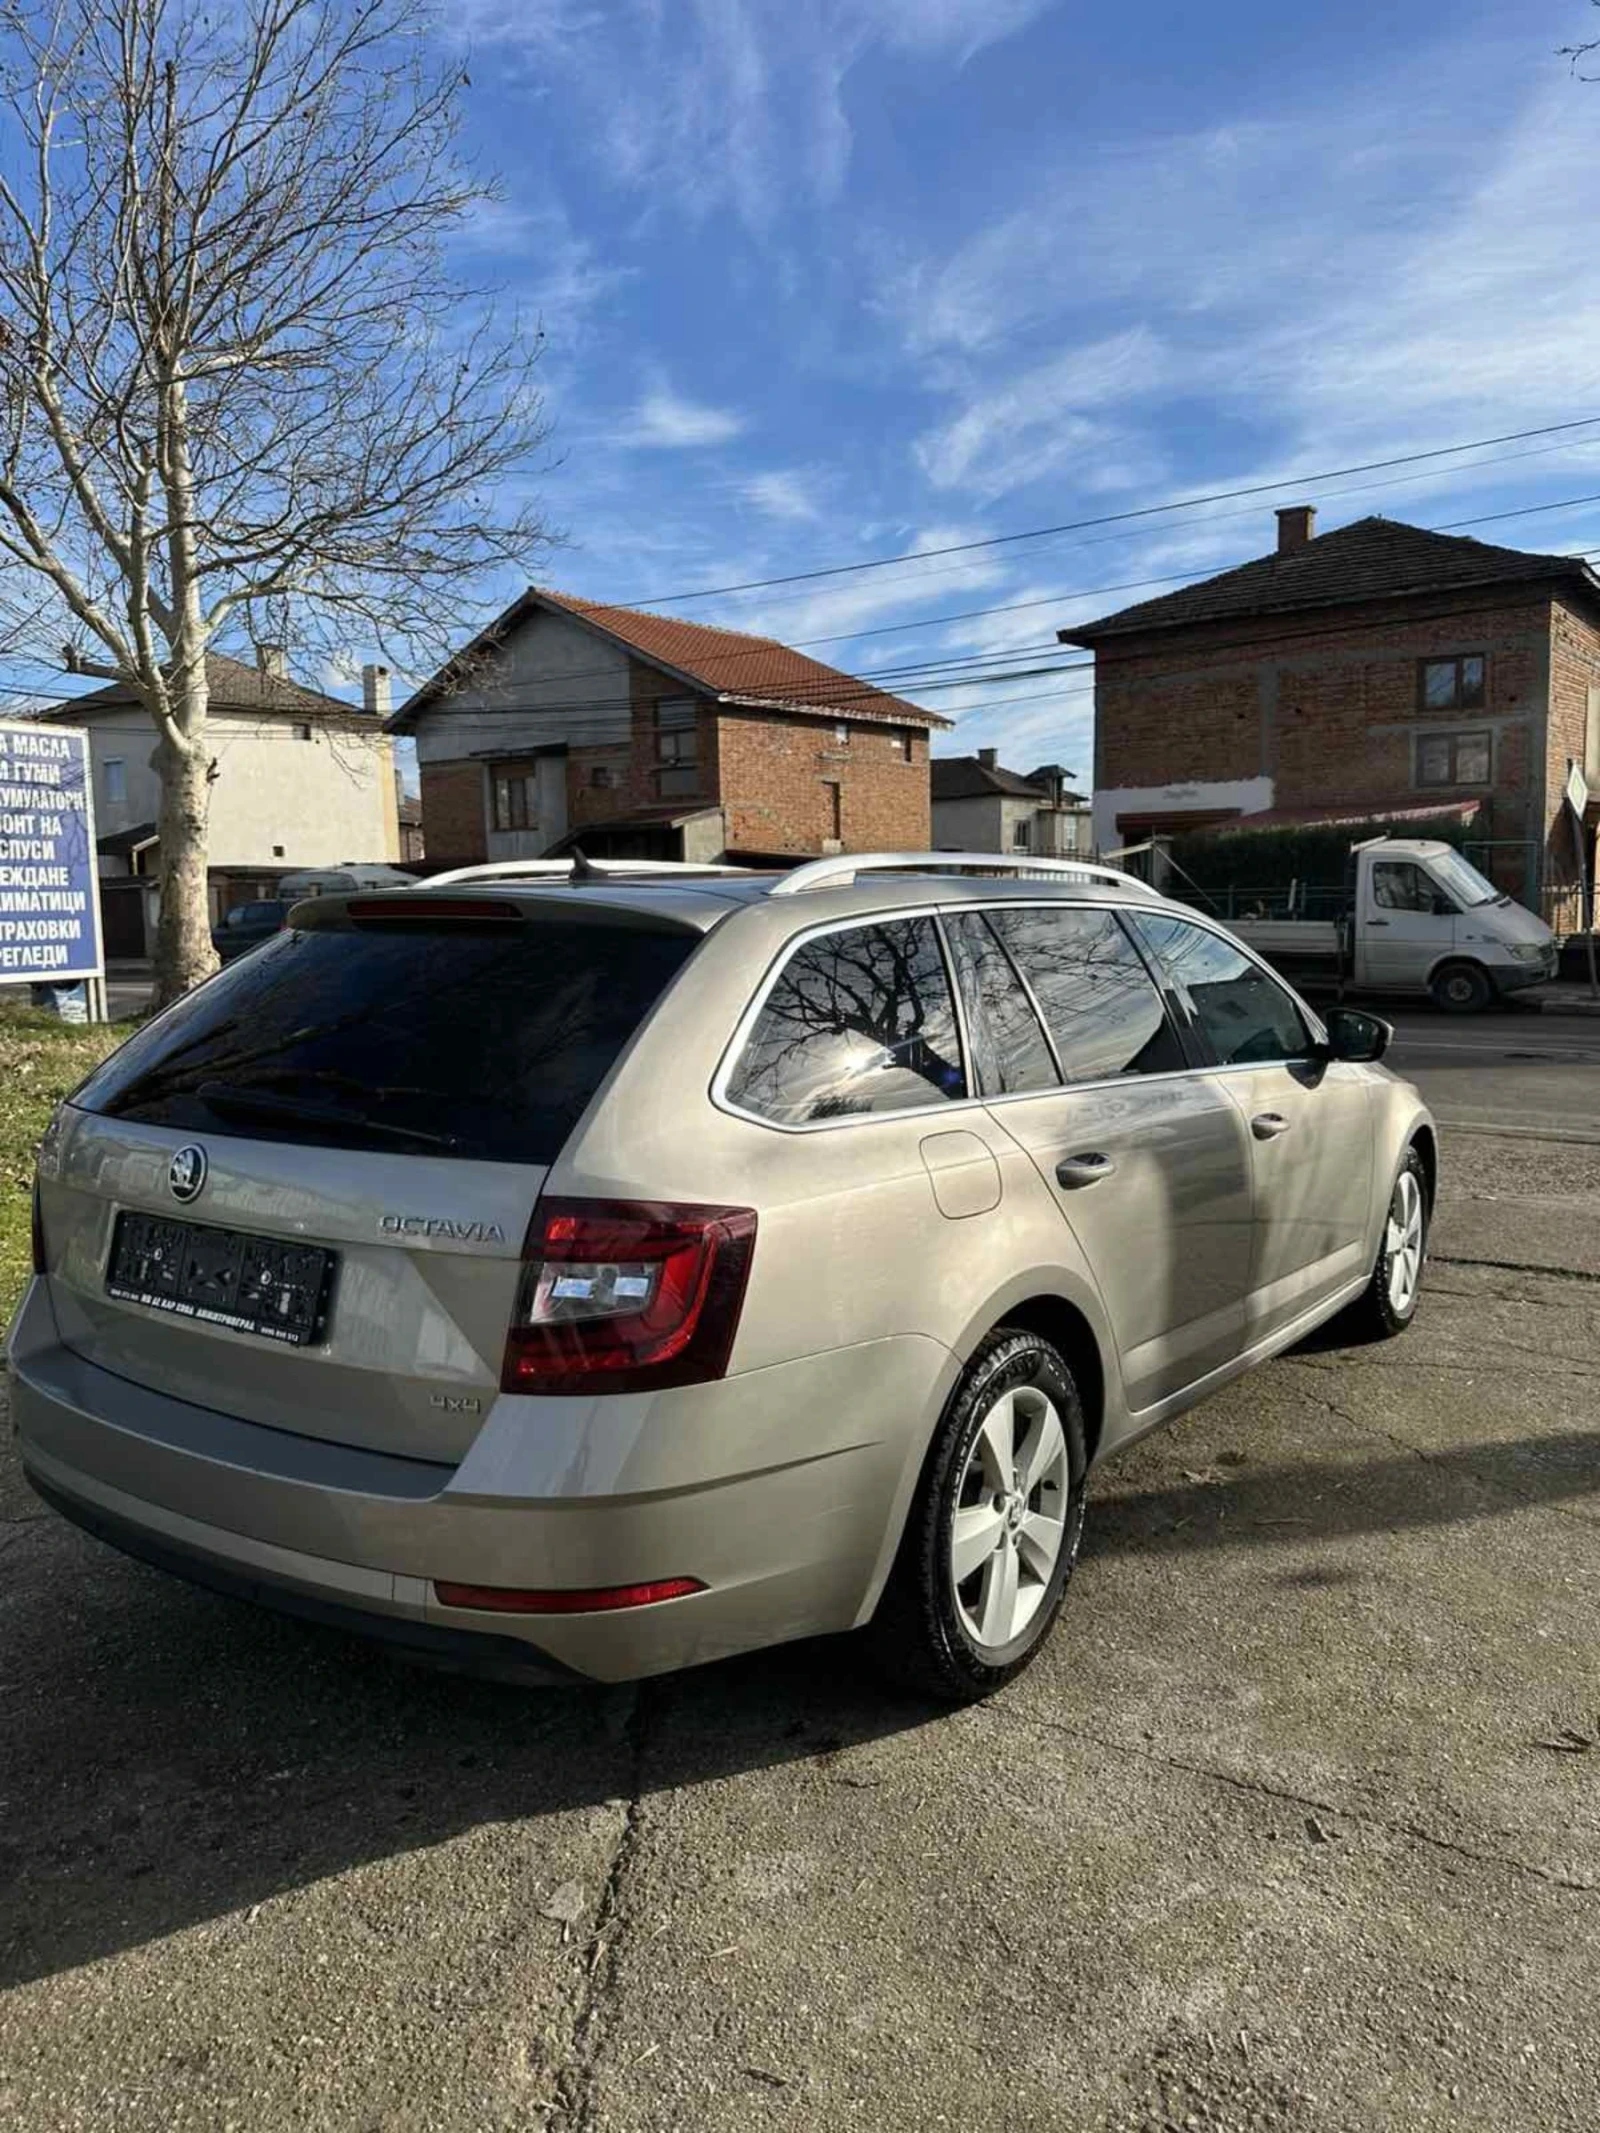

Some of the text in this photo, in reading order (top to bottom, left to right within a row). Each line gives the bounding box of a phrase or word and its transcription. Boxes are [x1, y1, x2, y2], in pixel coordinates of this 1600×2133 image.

[14, 735, 71, 760] МАСЛА
[0, 815, 63, 836] ОНТ НА
[0, 866, 69, 889] ЕЖДАНЕ
[0, 891, 86, 914] ИМАТИЦИ
[0, 944, 69, 969] ЕГЛЕДИ
[380, 1216, 506, 1244] OCTAVIA
